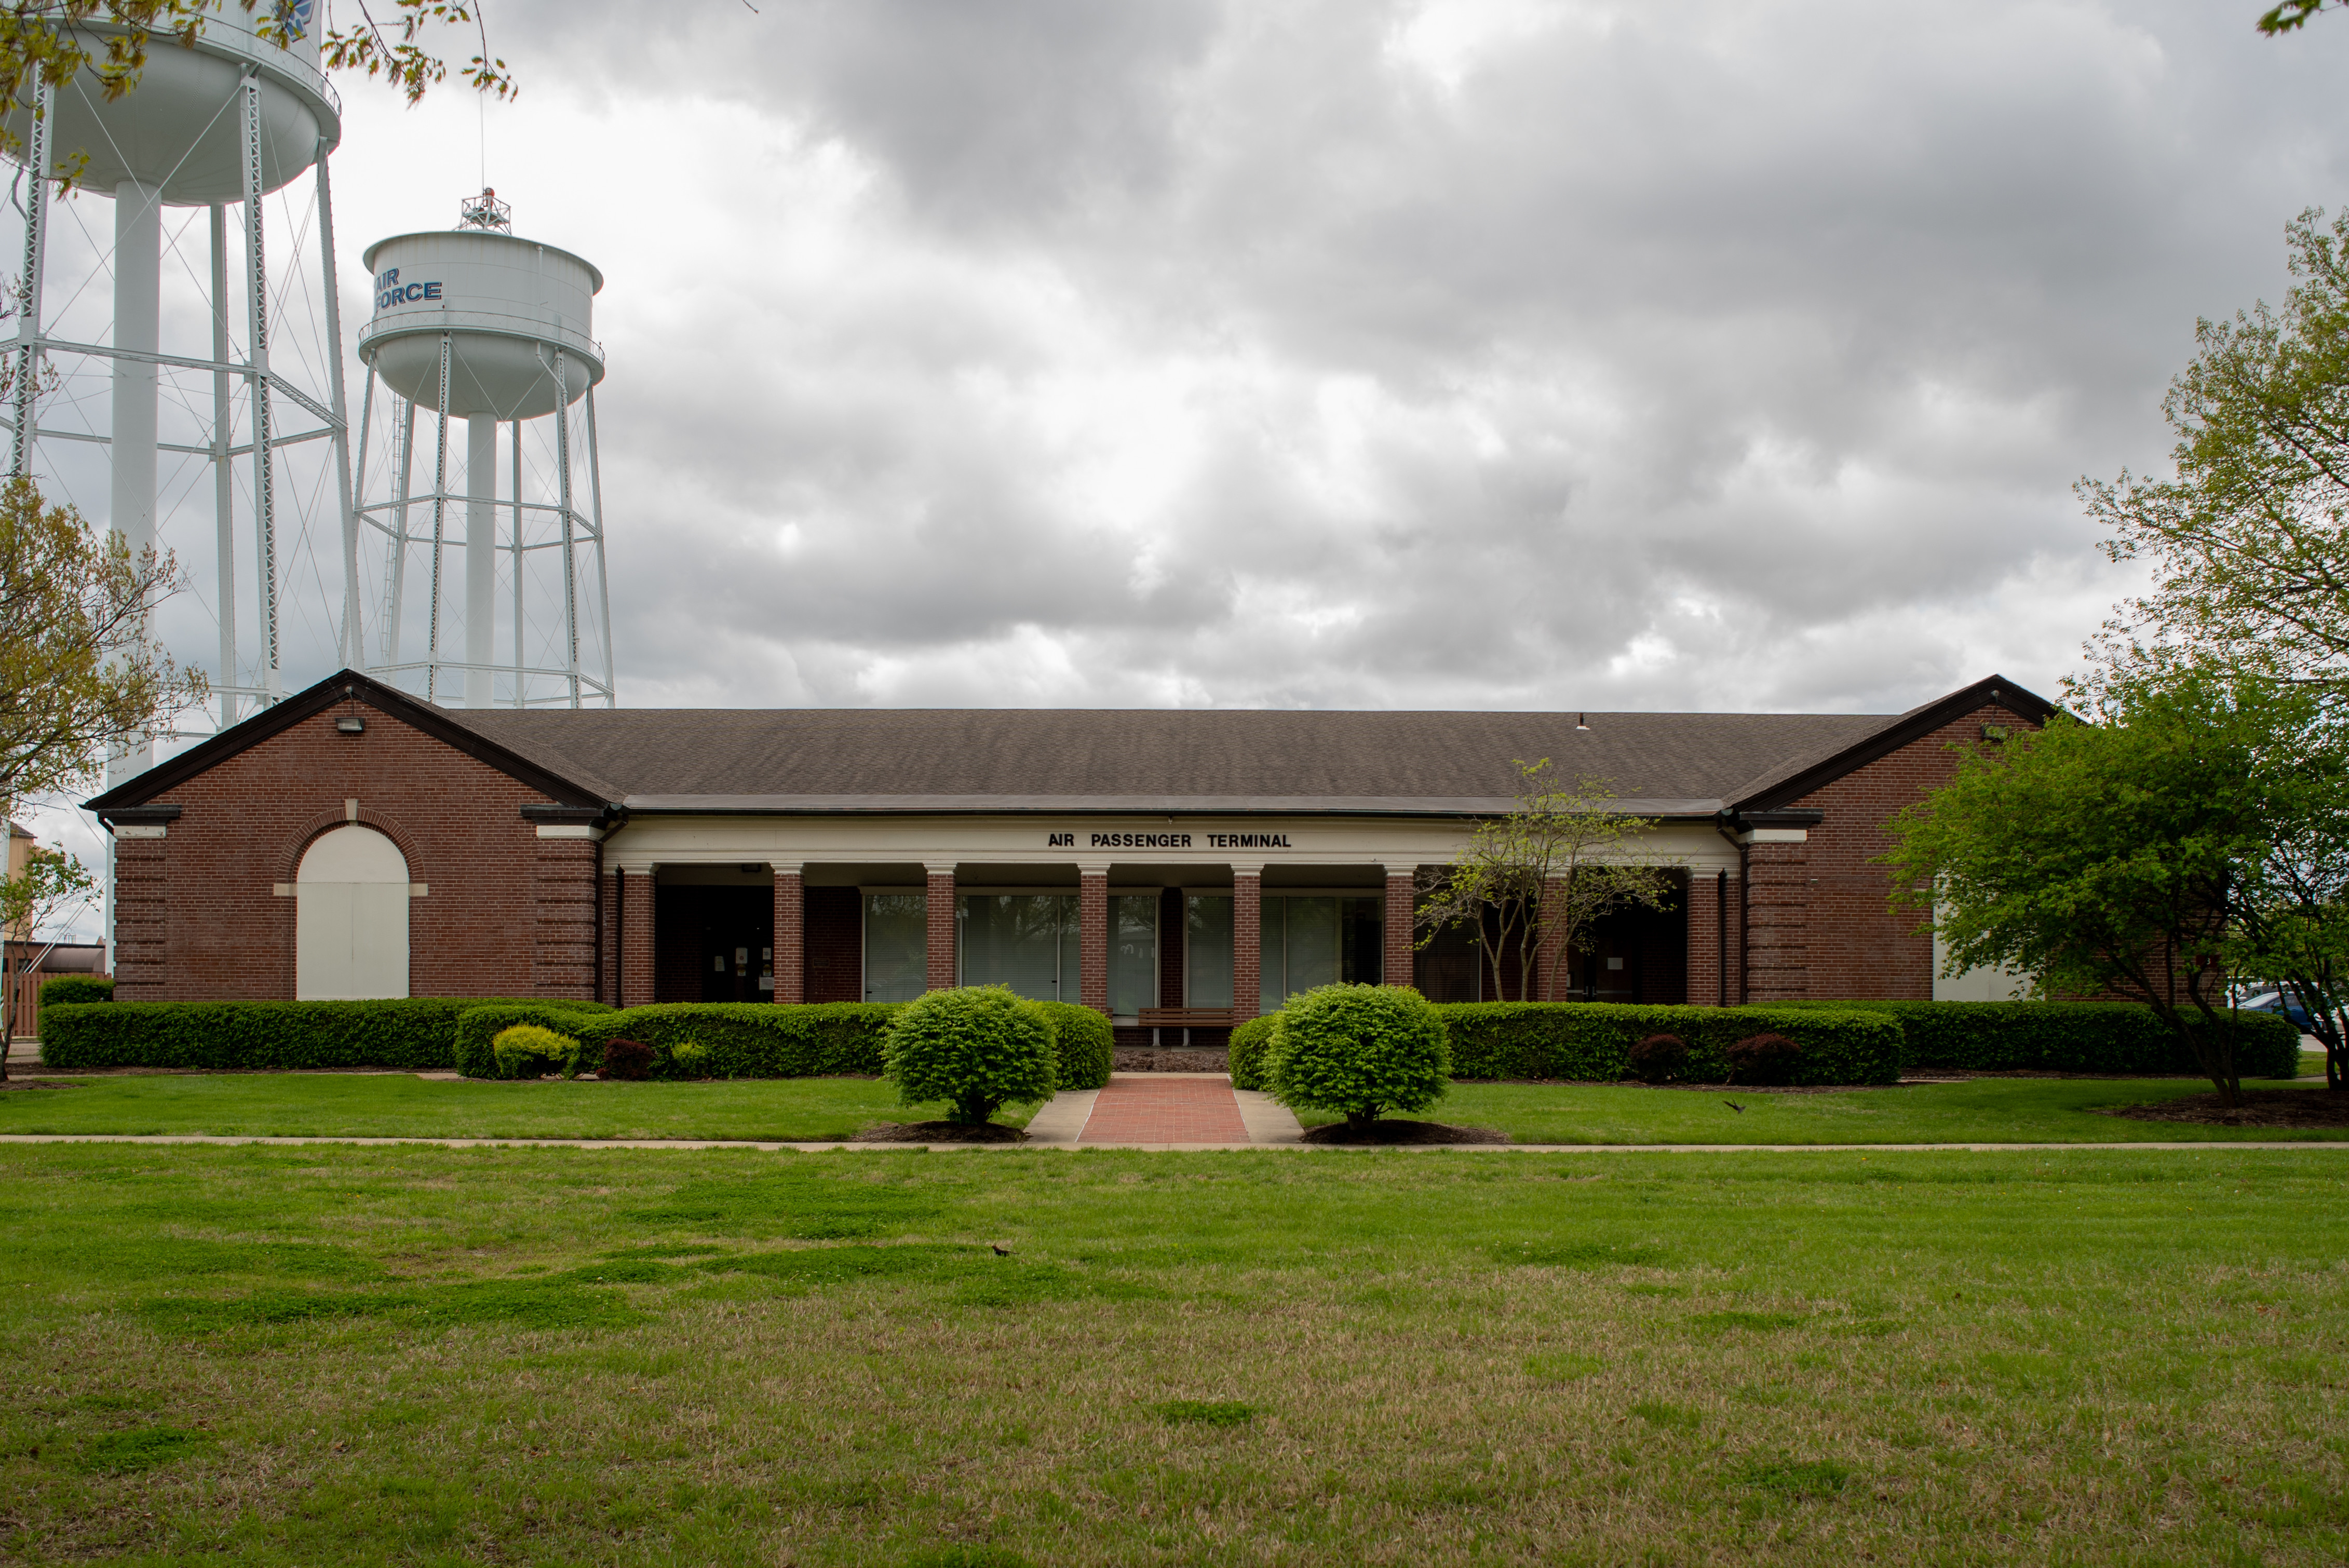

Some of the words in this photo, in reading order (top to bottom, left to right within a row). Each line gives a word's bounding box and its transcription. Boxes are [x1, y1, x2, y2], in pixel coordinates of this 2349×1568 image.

[375, 268, 400, 294] AIR
[375, 282, 442, 312] FORCE
[1048, 833, 1074, 847] AIR
[1091, 833, 1192, 847] PASSENGER
[1207, 834, 1291, 847] TERMINAL
